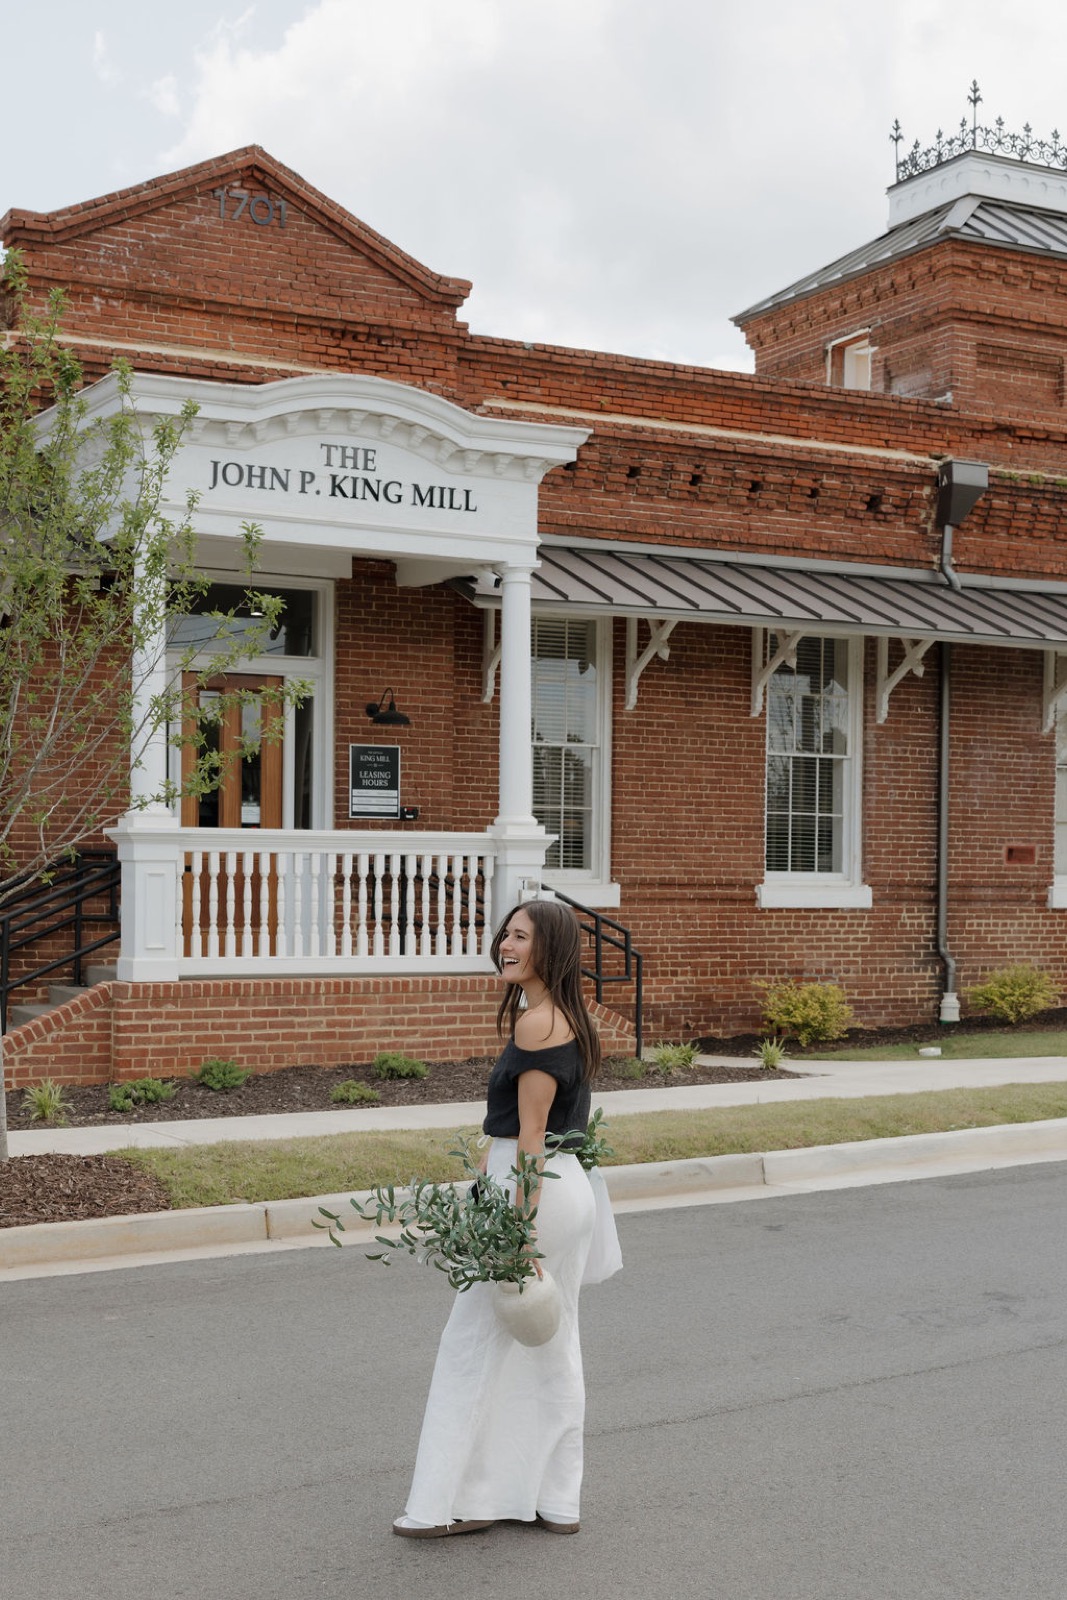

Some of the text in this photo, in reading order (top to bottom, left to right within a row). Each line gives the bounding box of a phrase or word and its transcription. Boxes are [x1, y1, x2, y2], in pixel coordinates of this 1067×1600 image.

[214, 190, 286, 229] 1701
[320, 443, 377, 472] THE
[208, 460, 478, 513] JOHN P. KING MILL
